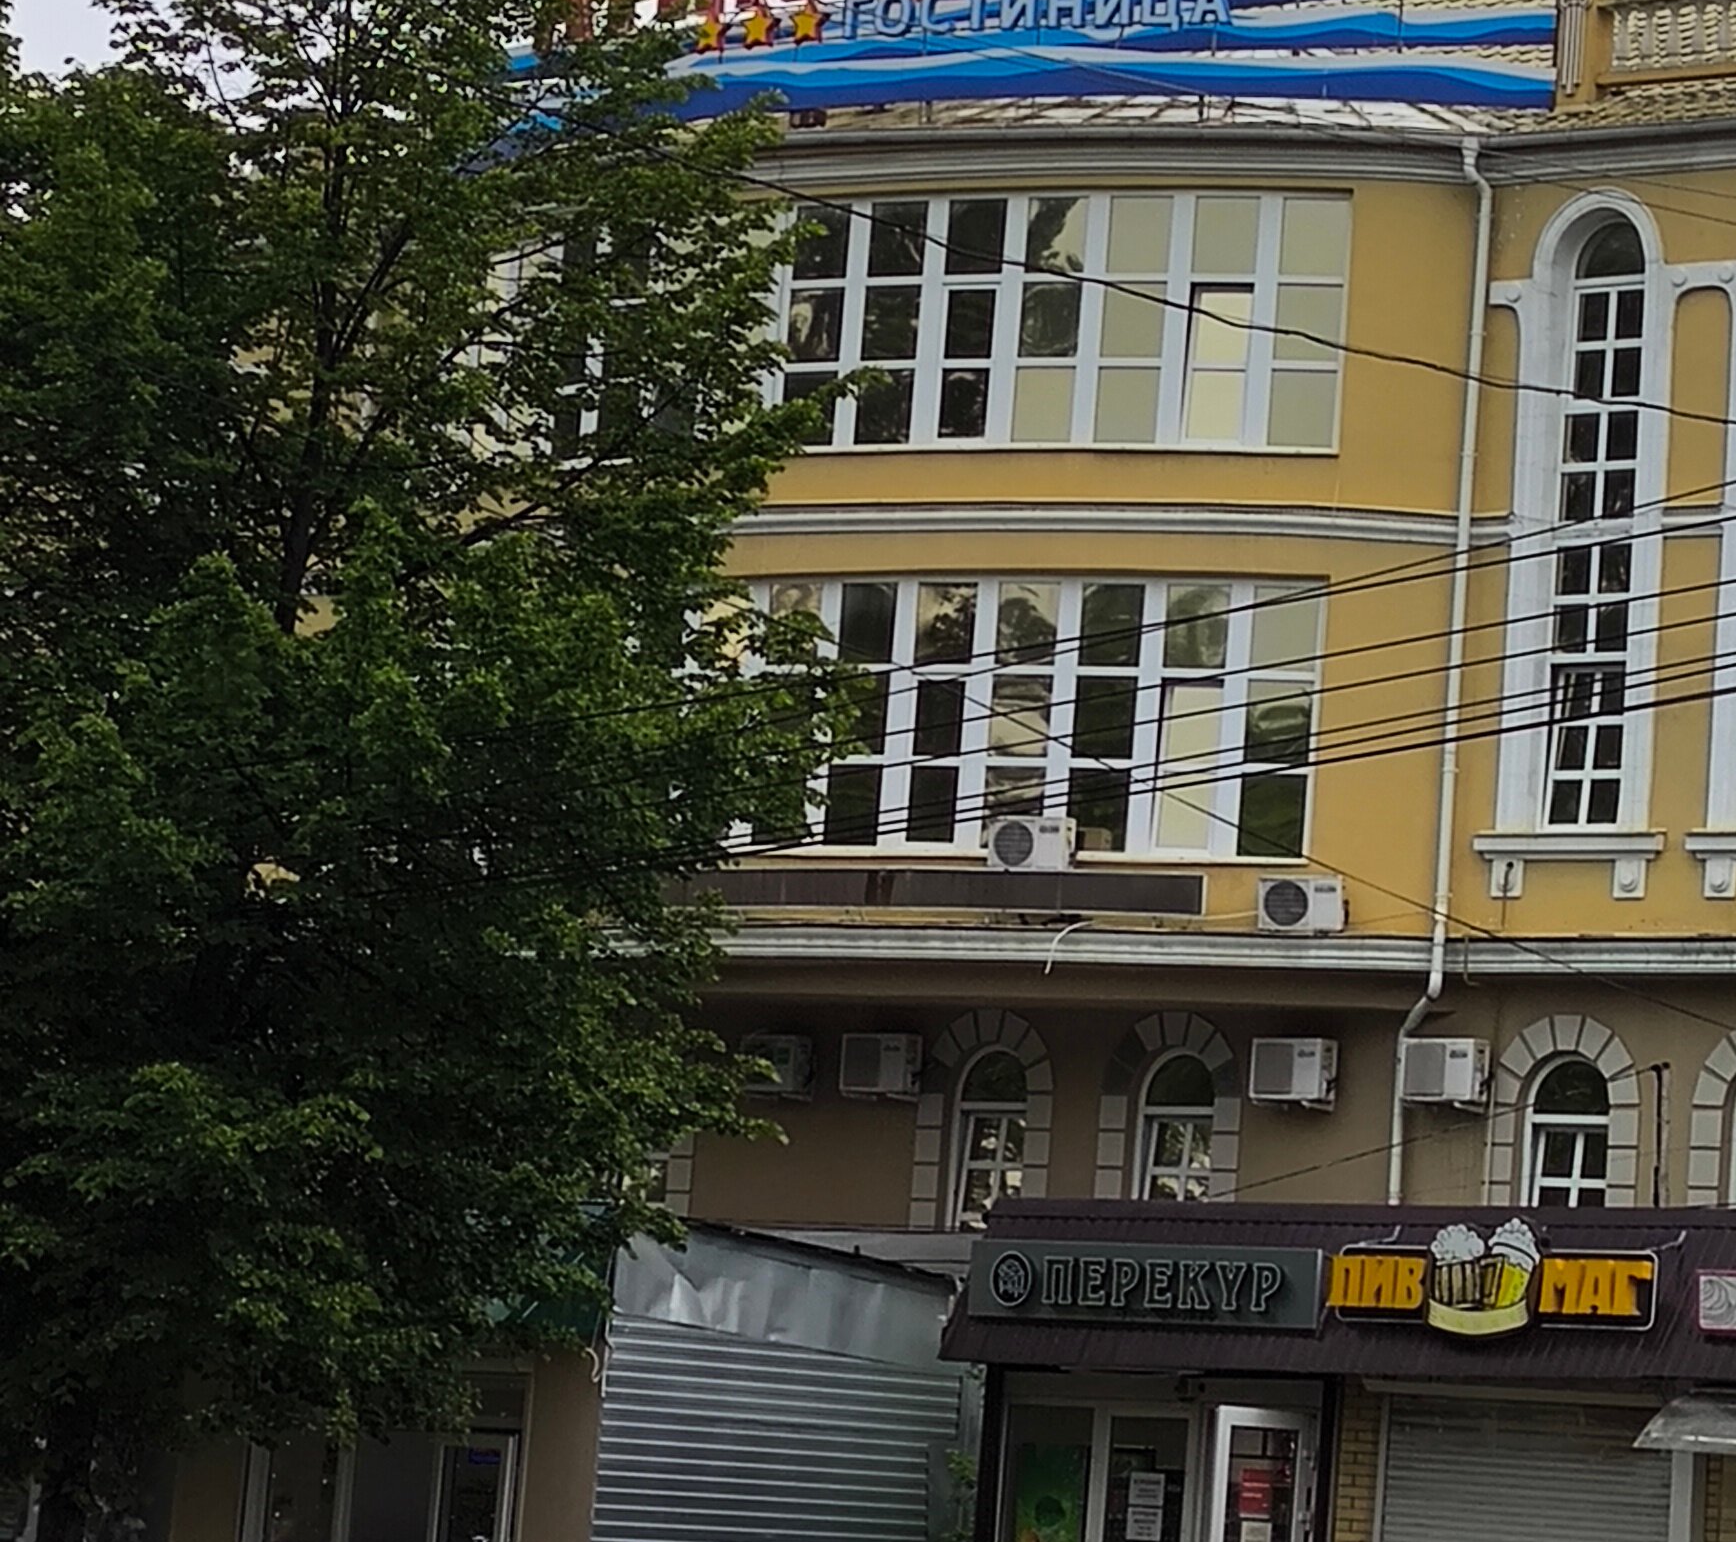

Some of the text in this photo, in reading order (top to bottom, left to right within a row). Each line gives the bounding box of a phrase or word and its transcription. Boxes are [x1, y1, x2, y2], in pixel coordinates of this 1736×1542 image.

[1041, 1256, 1282, 1311] ПЕРЕКУР
[1327, 1254, 1655, 1316] ПИВ МАГ
